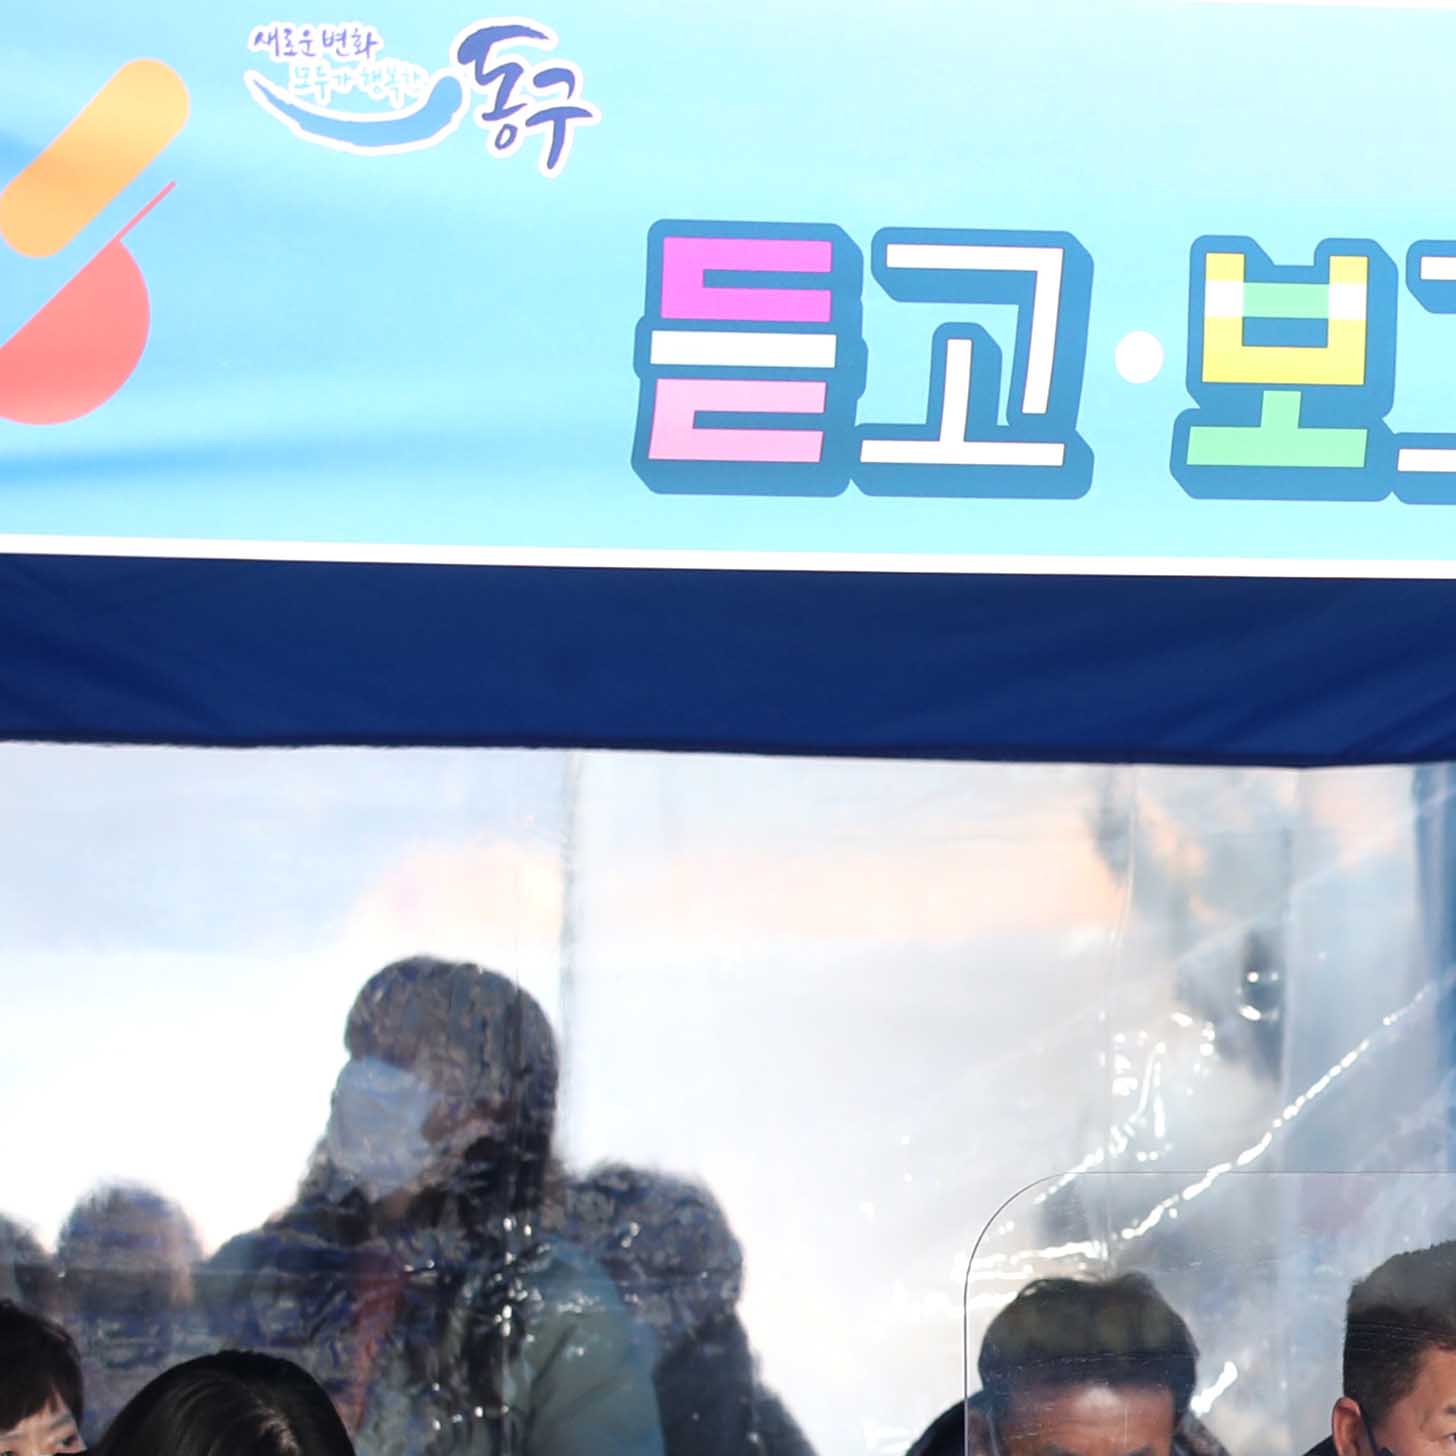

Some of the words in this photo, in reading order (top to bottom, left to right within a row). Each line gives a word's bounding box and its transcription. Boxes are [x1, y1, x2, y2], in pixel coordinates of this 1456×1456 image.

[253, 28, 315, 57] 새로운
[322, 28, 379, 59] 변화
[456, 24, 594, 170] 동구
